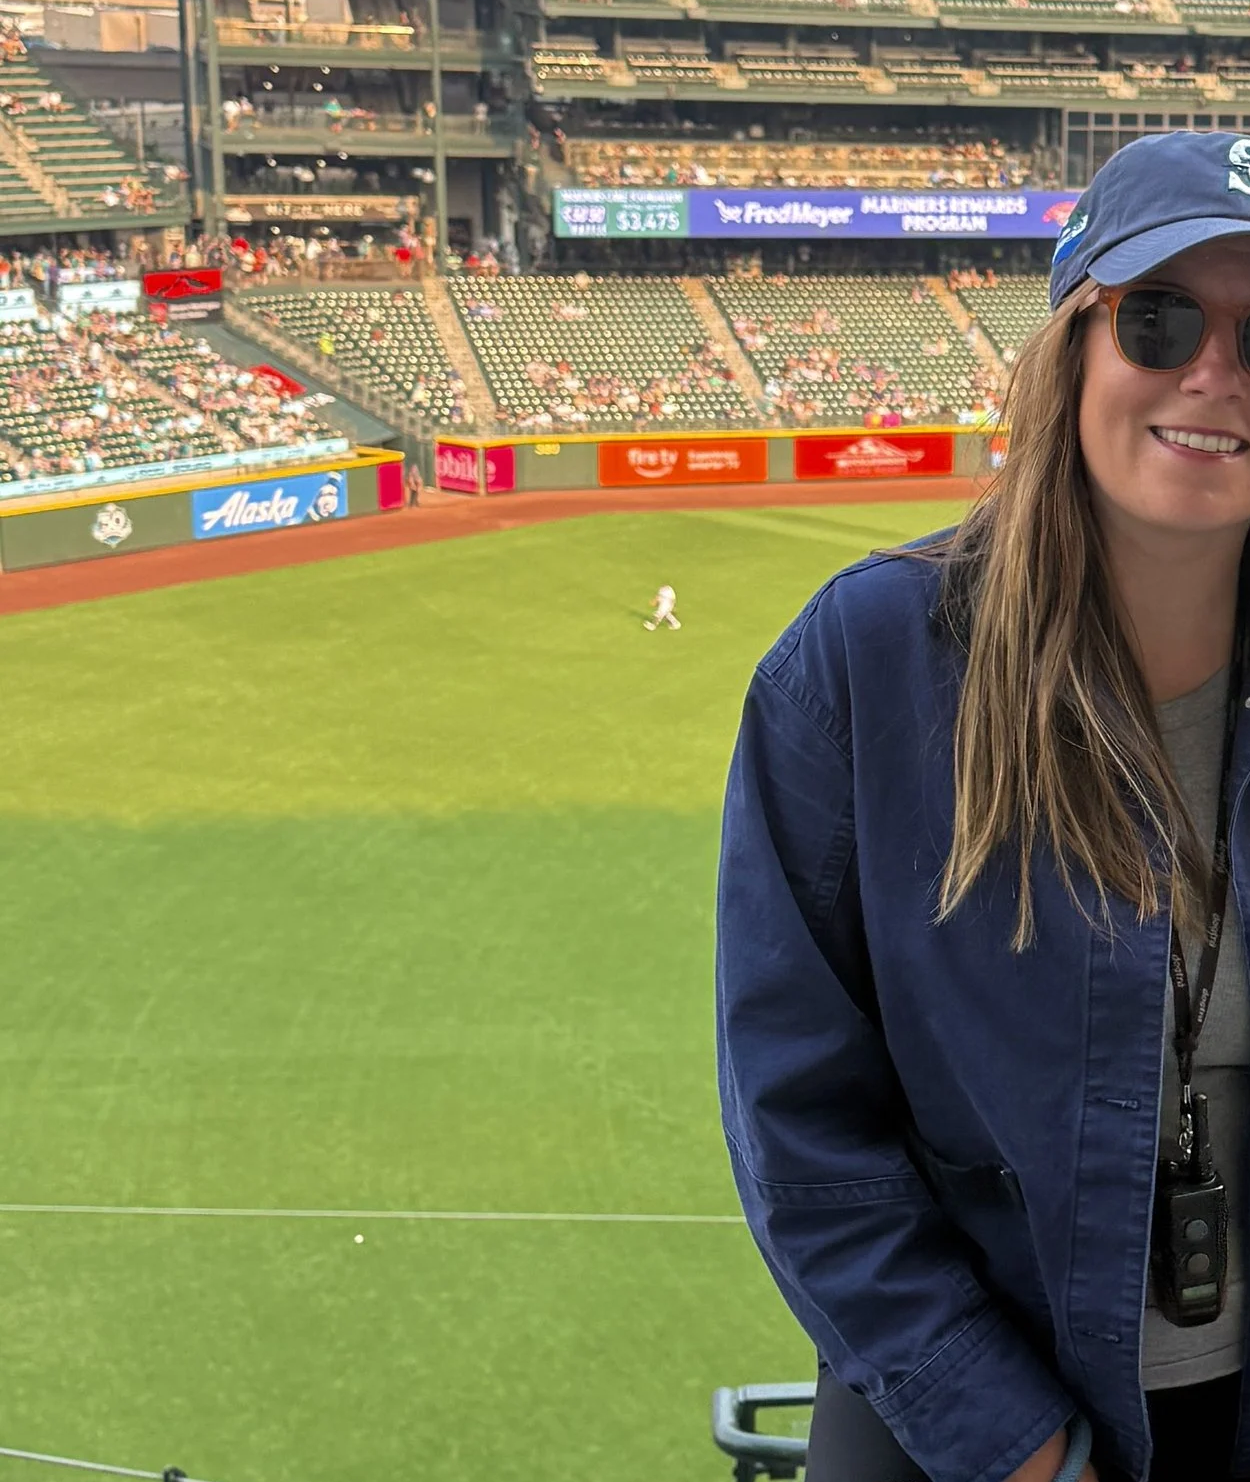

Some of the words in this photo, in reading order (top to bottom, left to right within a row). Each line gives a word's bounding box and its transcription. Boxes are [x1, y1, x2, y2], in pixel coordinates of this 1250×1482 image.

[860, 195, 947, 215] MARINERS
[950, 195, 1028, 215] REWARDS
[902, 215, 988, 232] PROGRAM
[202, 488, 299, 531] Alaska
